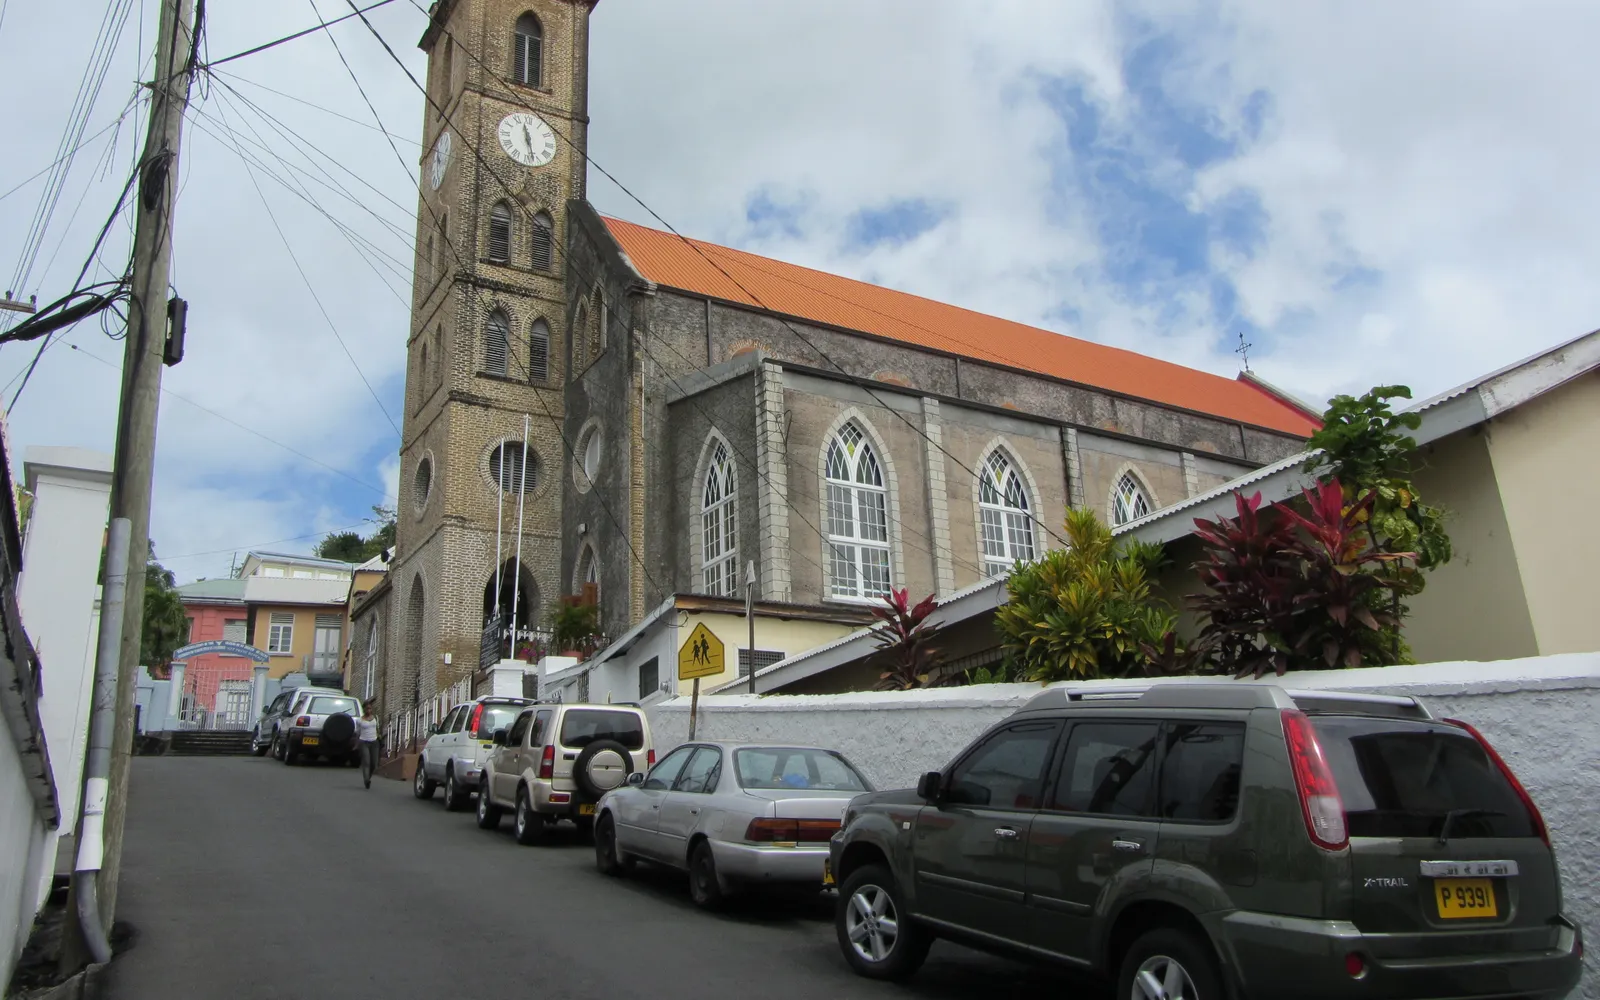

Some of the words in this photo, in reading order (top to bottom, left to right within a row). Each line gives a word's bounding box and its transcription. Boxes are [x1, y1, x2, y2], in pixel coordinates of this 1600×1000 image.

[1364, 878, 1408, 887] X-TRAIL
[1441, 887, 1451, 908] P
[1456, 887, 1490, 908] 9391
